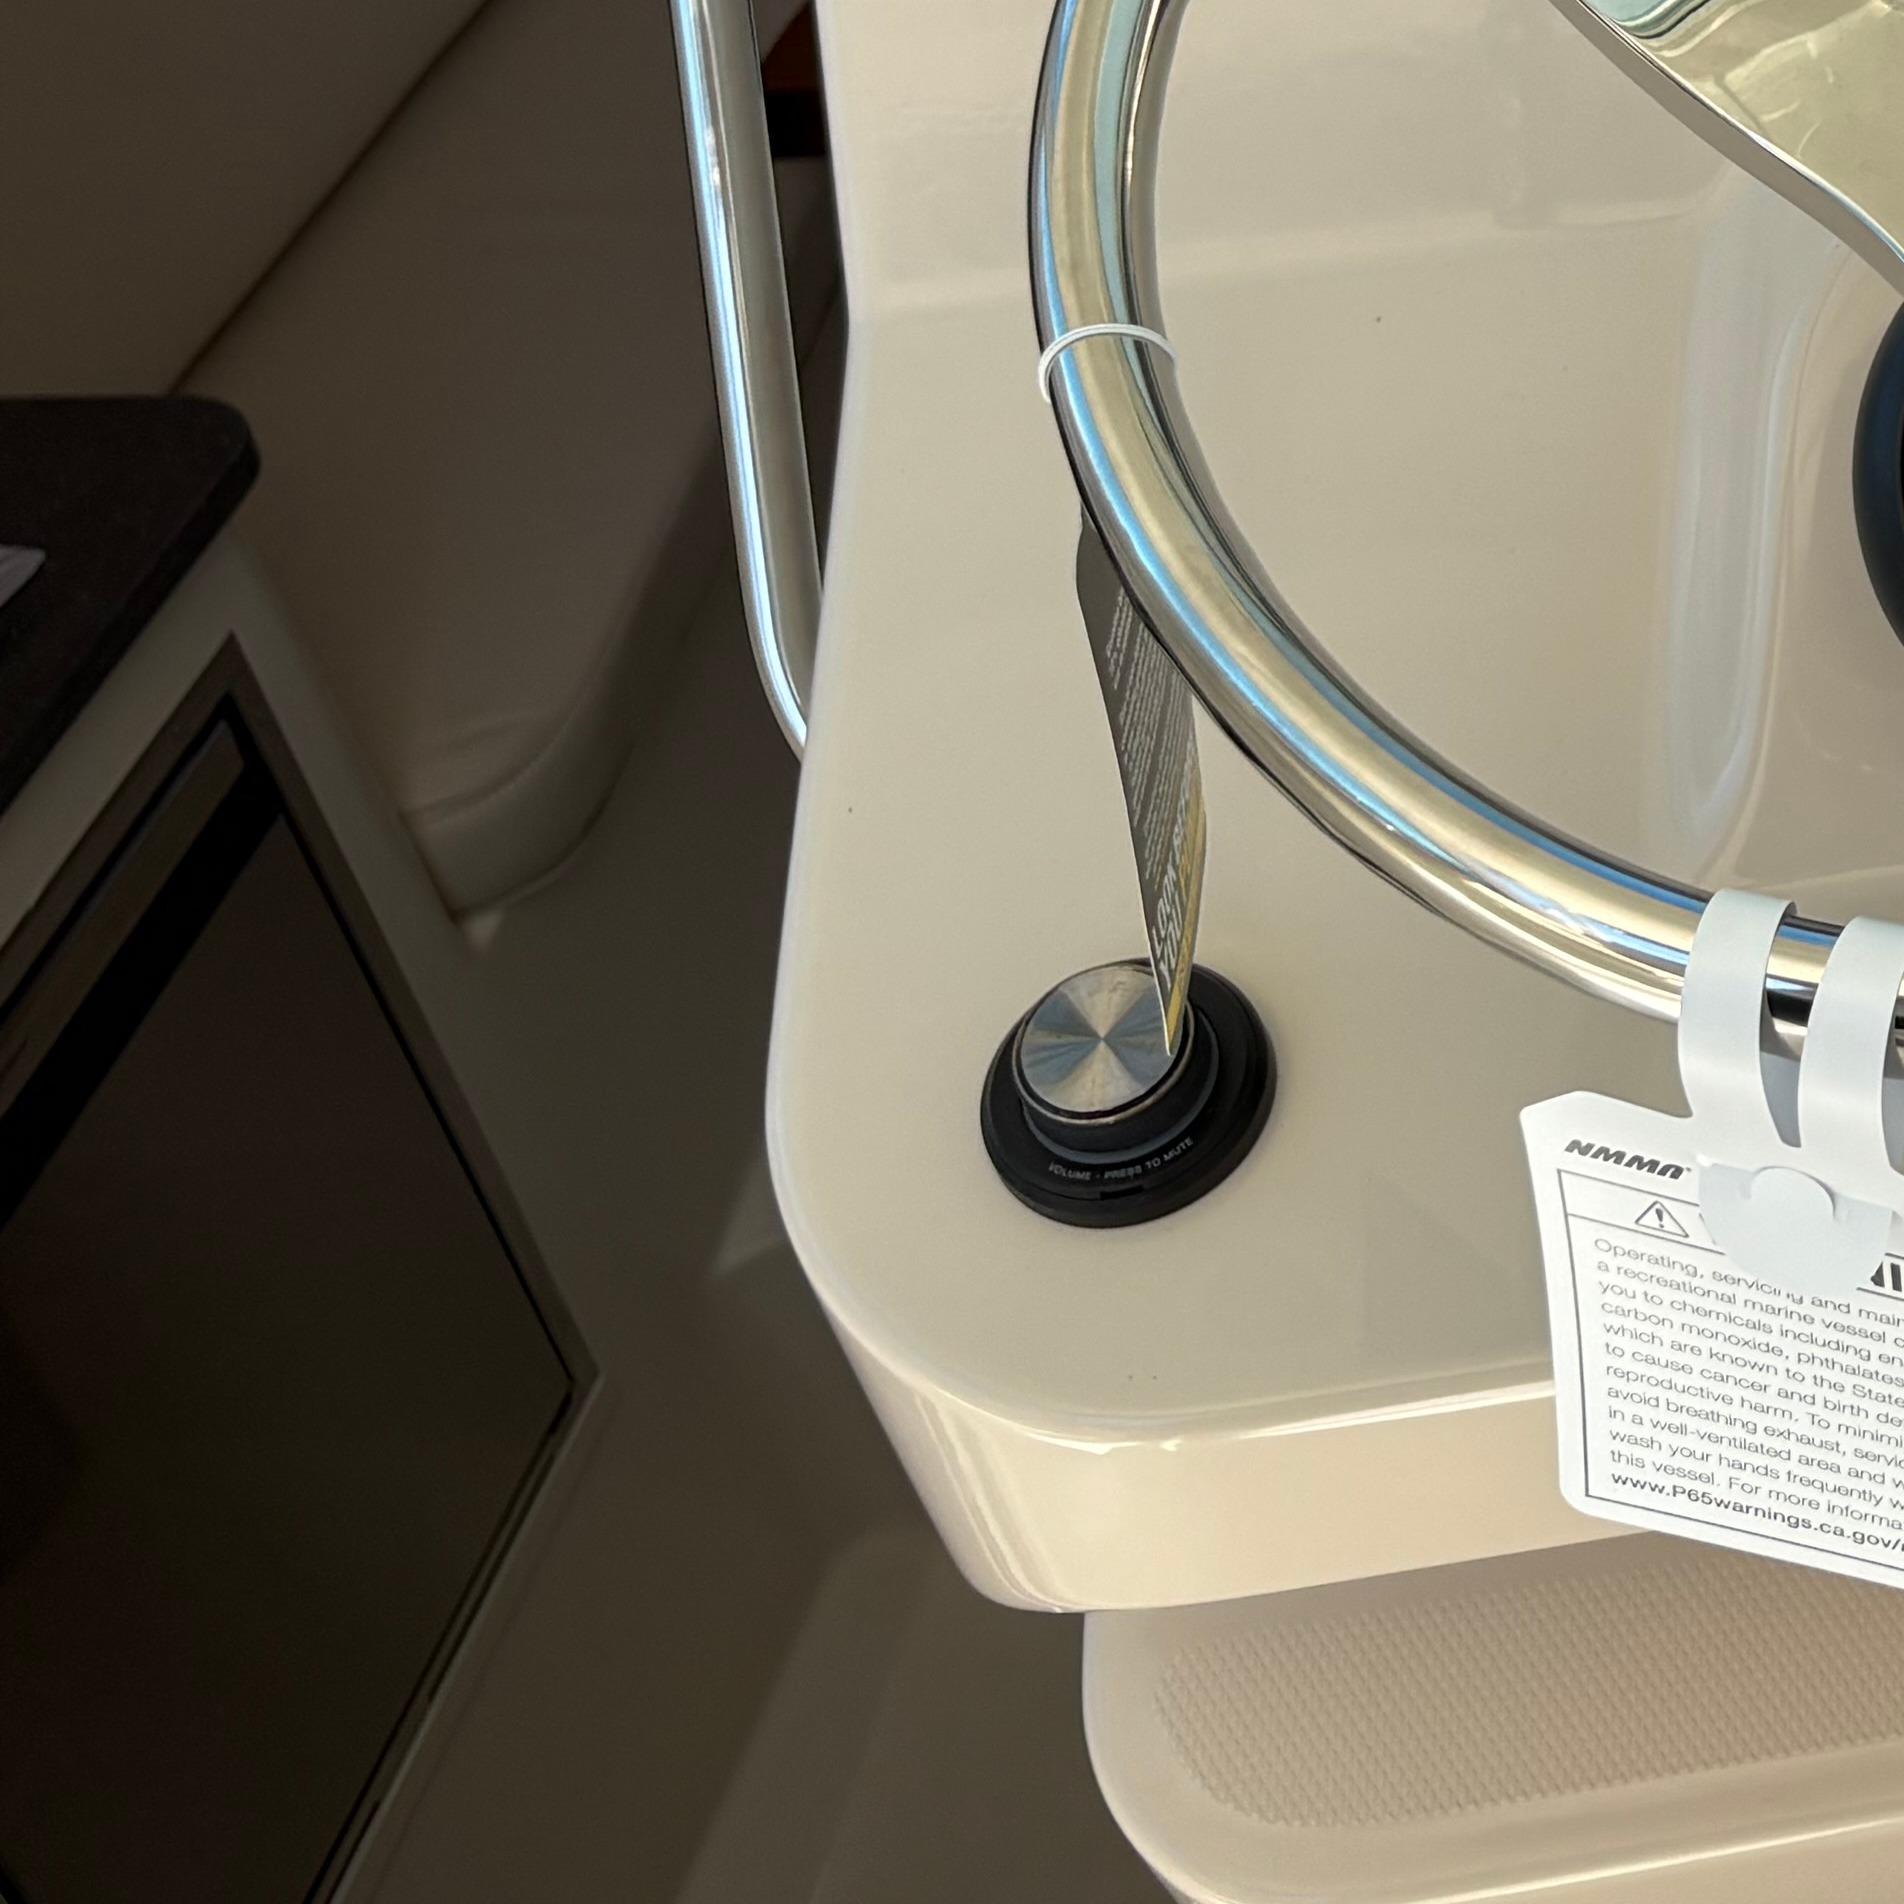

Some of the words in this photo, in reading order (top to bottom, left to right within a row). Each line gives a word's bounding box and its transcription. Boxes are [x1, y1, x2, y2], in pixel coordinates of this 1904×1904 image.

[1145, 1158, 1161, 1169] TO
[1594, 1236, 1704, 1280] Operating,
[1810, 1293, 1850, 1315] and
[1616, 1263, 1736, 1306] recreational
[1743, 1295, 1814, 1325] marine
[1821, 1315, 1886, 1343] vessel
[1598, 1279, 1636, 1302] you
[1670, 1297, 1772, 1335] chemicals
[1780, 1325, 1871, 1362] including
[1600, 1299, 1673, 1329] carbon
[1680, 1319, 1789, 1359] monoxide,
[1603, 1320, 1663, 1347] which
[1670, 1339, 1702, 1357] are
[1709, 1347, 1777, 1376] known
[1812, 1373, 1845, 1393] the
[1605, 1361, 1733, 1408] reproductive
[1740, 1395, 1798, 1422] harm.
[1606, 1383, 1660, 1409] avoid
[1666, 1397, 1757, 1435] breathing
[1763, 1422, 1846, 1457] exhaust,
[1631, 1350, 1693, 1375] cause
[1699, 1366, 1770, 1395] cancer
[1776, 1384, 1815, 1406] and
[1823, 1396, 1868, 1419] birth
[1609, 1425, 1661, 1451] wash
[1668, 1442, 1712, 1467] your
[1718, 1452, 1780, 1480] hands
[1786, 1469, 1883, 1508] frequently
[1609, 1446, 1645, 1469] this
[1651, 1457, 1720, 1487] vessel.
[1727, 1476, 1761, 1497] For
[1768, 1488, 1820, 1511] more
[1650, 1414, 1791, 1462] well-ventilated
[1797, 1454, 1841, 1474] area
[1847, 1464, 1885, 1485] and
